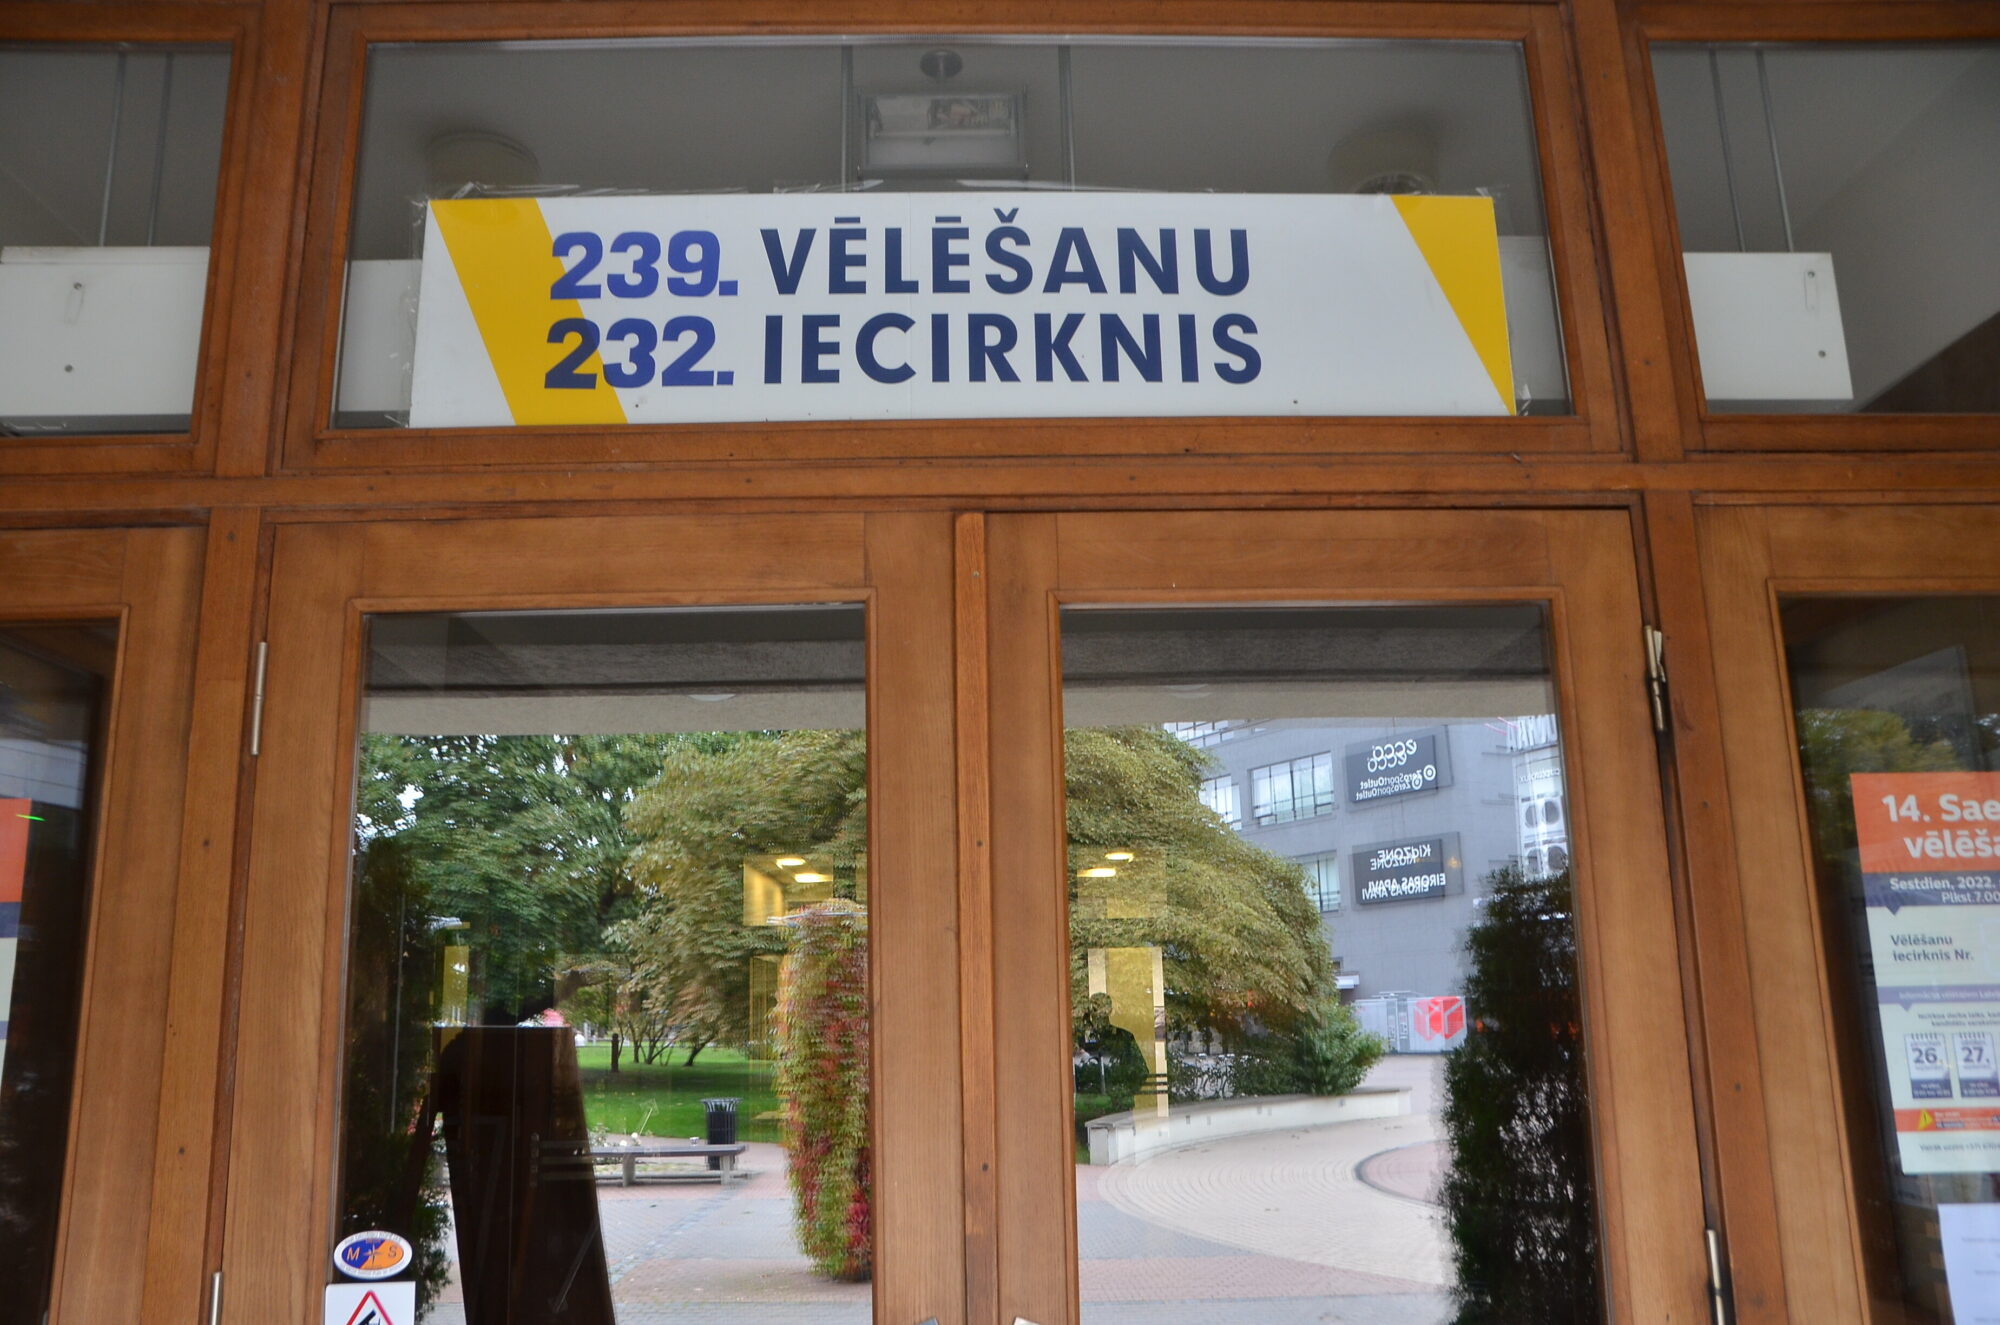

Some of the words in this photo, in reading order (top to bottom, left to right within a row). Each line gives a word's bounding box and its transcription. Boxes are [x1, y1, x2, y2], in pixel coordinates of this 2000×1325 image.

[550, 230, 739, 300] 239.
[760, 207, 1251, 296] VĒLĒŠANU
[543, 315, 735, 391] 232.
[763, 312, 1263, 386] IECIRKNIS
[1881, 795, 1931, 822] 14.
[1957, 876, 1996, 889] 2022.
[1890, 934, 1953, 946] Vēlēšanu
[1961, 1046, 1990, 1063] 27.
[346, 1247, 361, 1262] M
